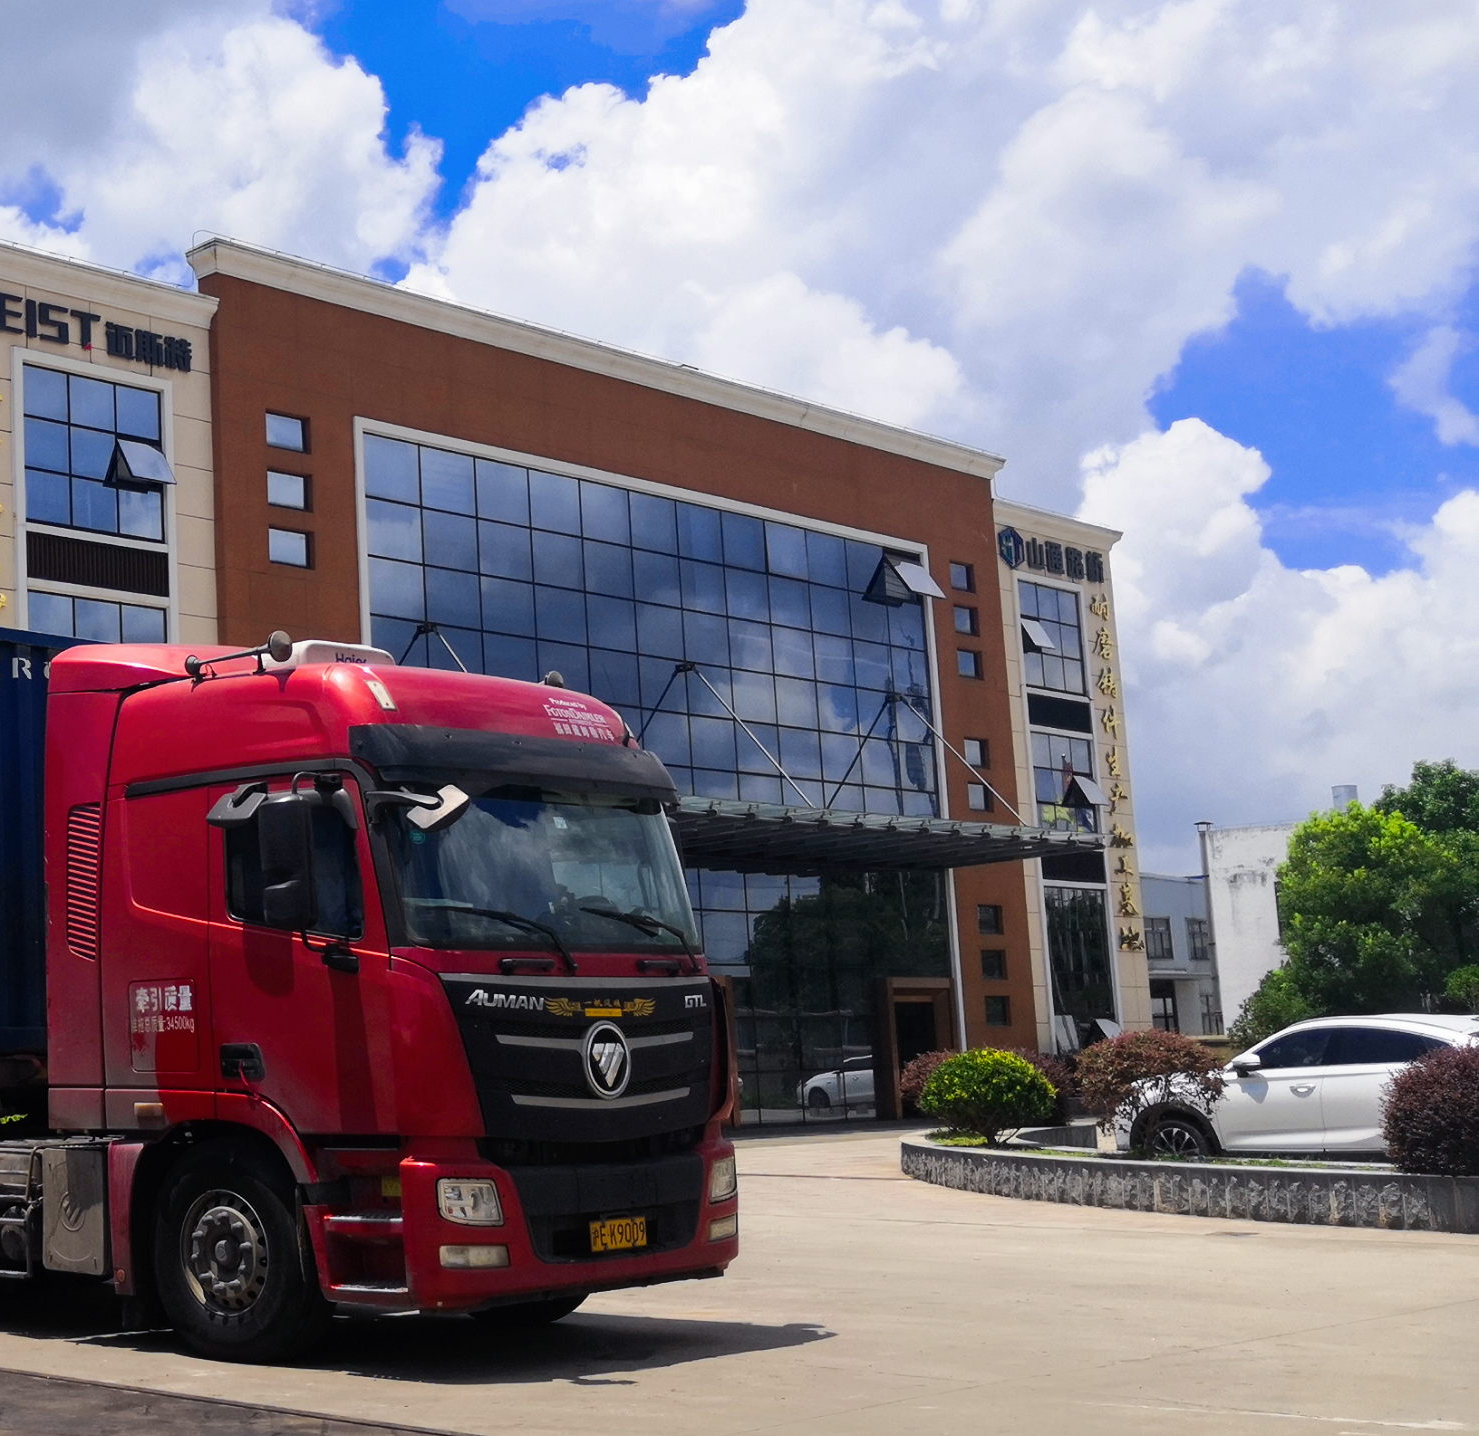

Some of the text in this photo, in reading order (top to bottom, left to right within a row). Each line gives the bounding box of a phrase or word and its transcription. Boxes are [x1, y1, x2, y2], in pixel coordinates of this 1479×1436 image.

[104, 320, 193, 373] 迈斯特
[135, 985, 193, 1013] 牵引质量
[465, 989, 545, 1011] AUMAN
[684, 994, 707, 1009] GTL
